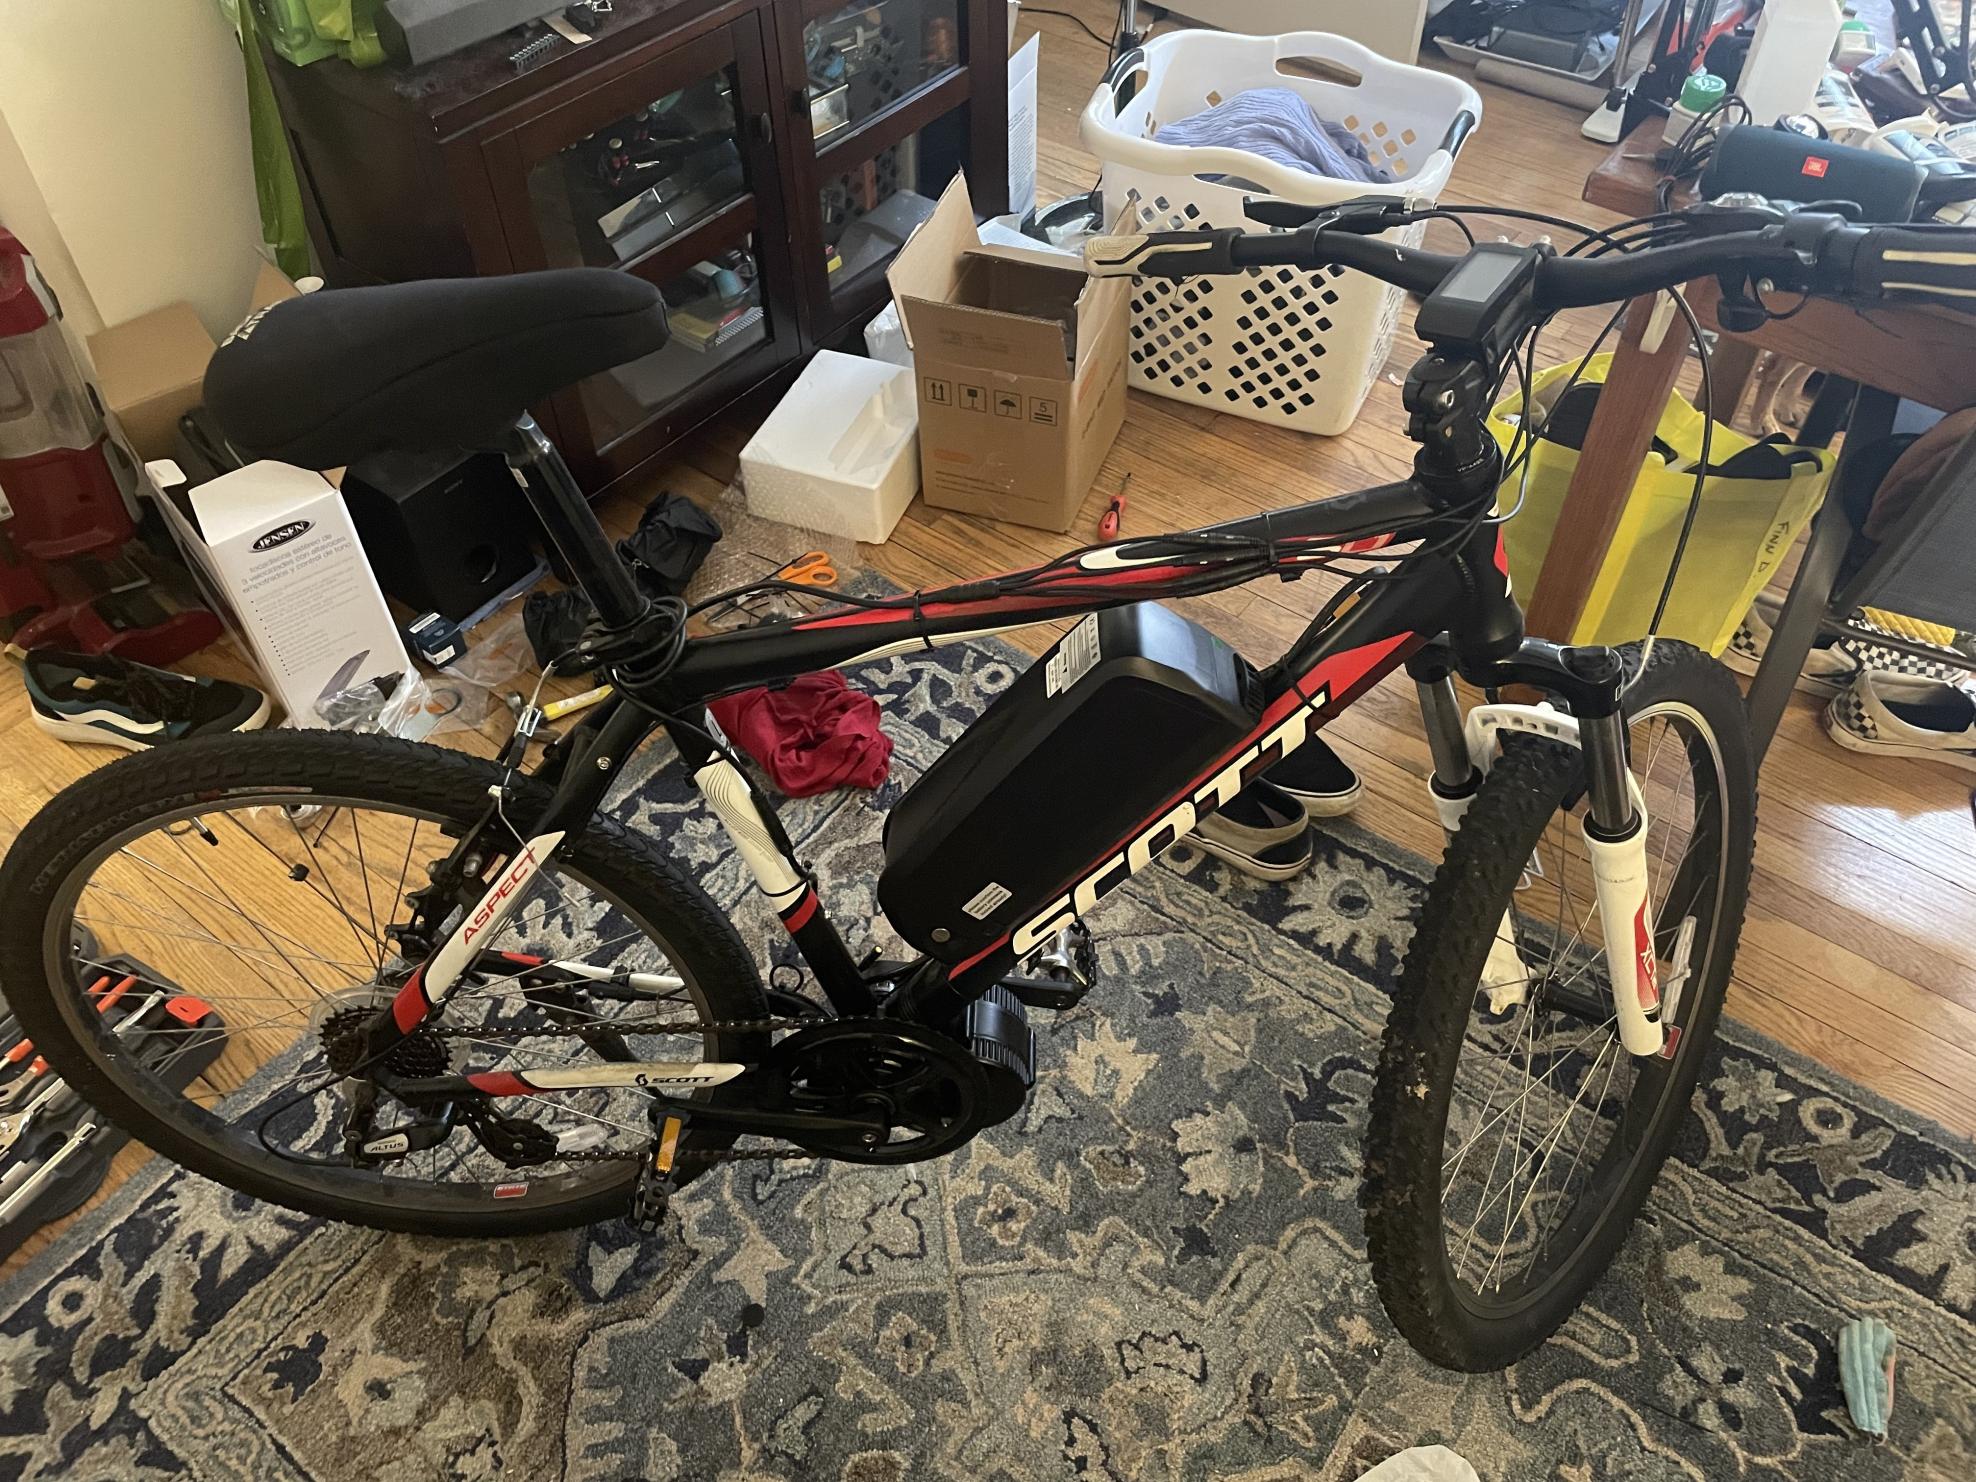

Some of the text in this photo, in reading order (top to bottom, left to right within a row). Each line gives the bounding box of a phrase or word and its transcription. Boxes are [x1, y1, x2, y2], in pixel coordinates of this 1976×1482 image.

[257, 522, 306, 549] JENSEN
[1765, 521, 1789, 554] FINN
[1013, 691, 1326, 956] SCOTT
[464, 847, 535, 944] ASPECT
[651, 1076, 714, 1084] SCOTT
[370, 1142, 404, 1152] ALTUS
